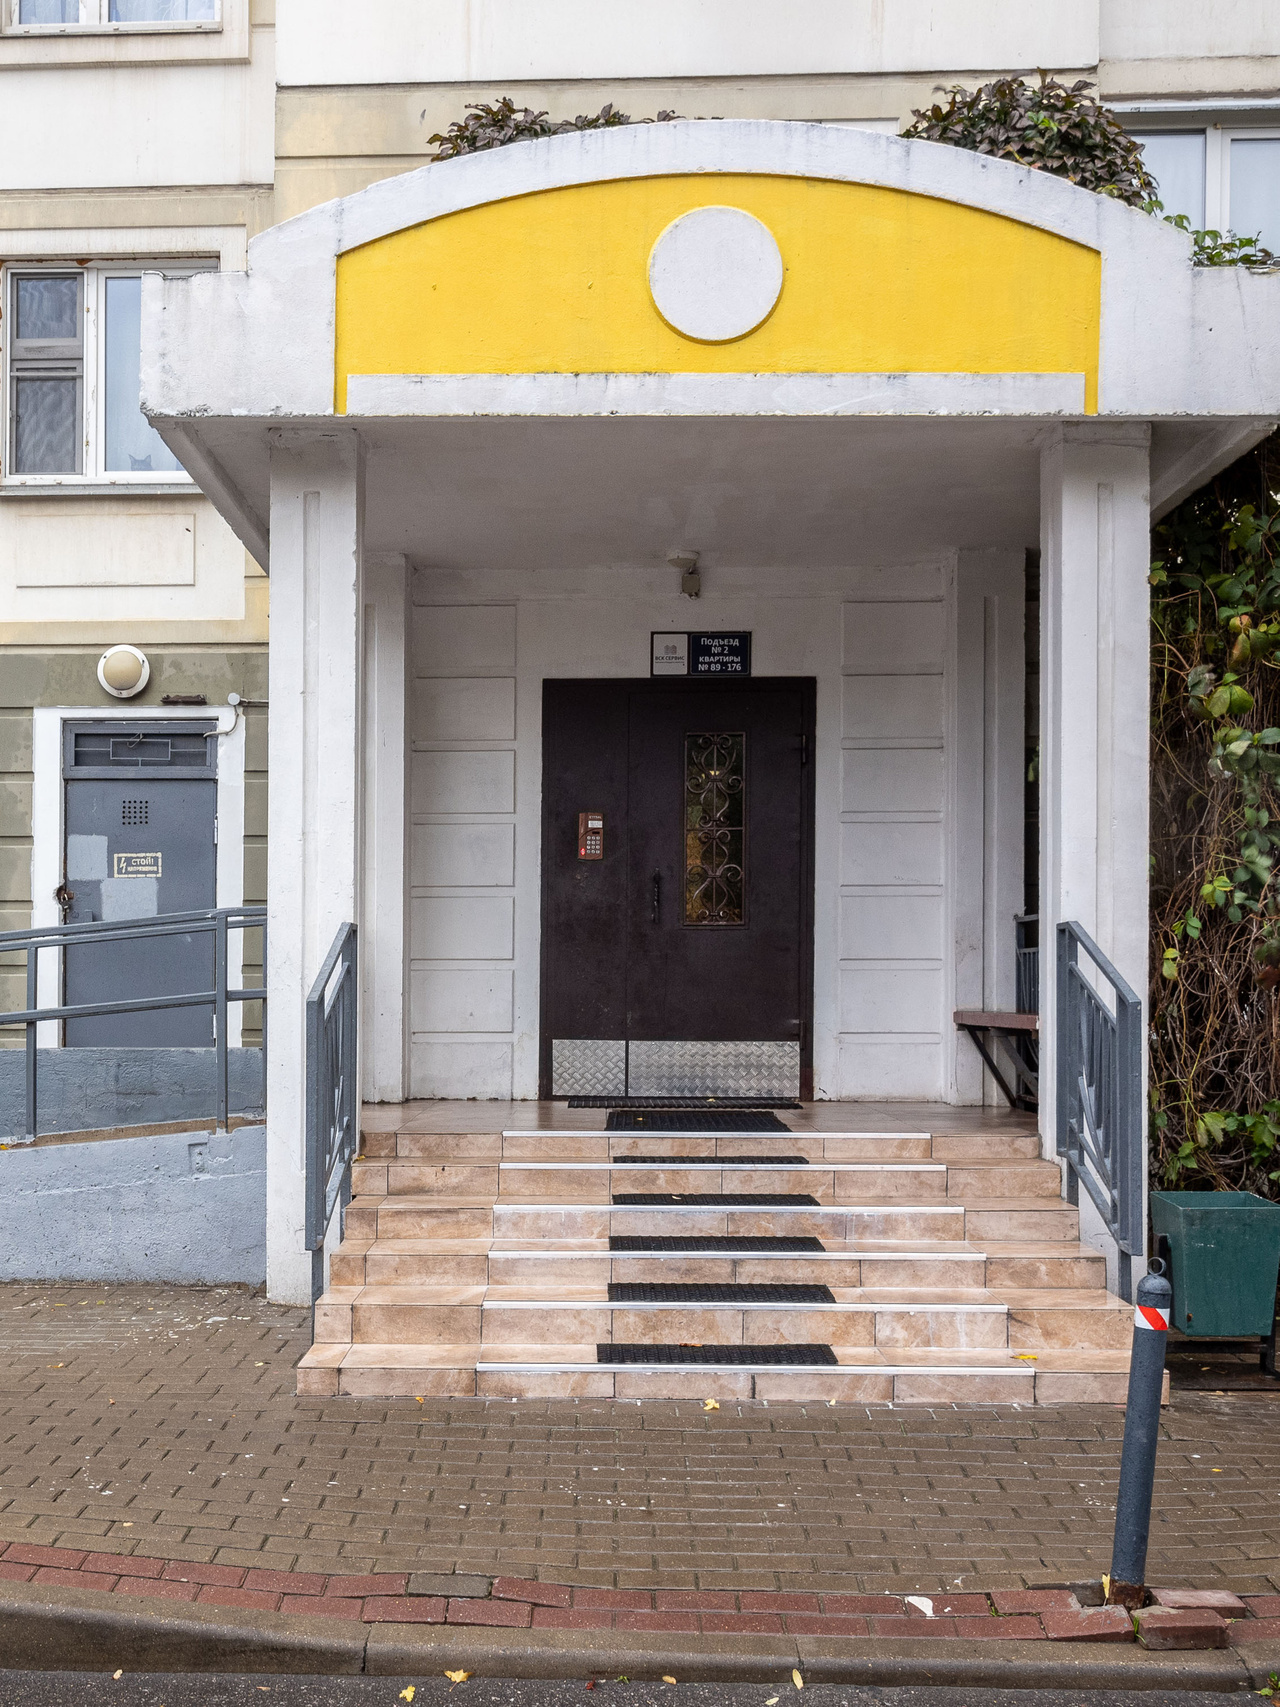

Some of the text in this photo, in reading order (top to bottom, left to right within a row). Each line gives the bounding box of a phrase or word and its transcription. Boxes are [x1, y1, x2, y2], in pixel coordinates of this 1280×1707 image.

[711, 646, 729, 654] № 2
[698, 663, 709, 671] №
[710, 663, 721, 671] 89
[727, 663, 742, 671] 176
[131, 857, 154, 866] СТОЙ!
